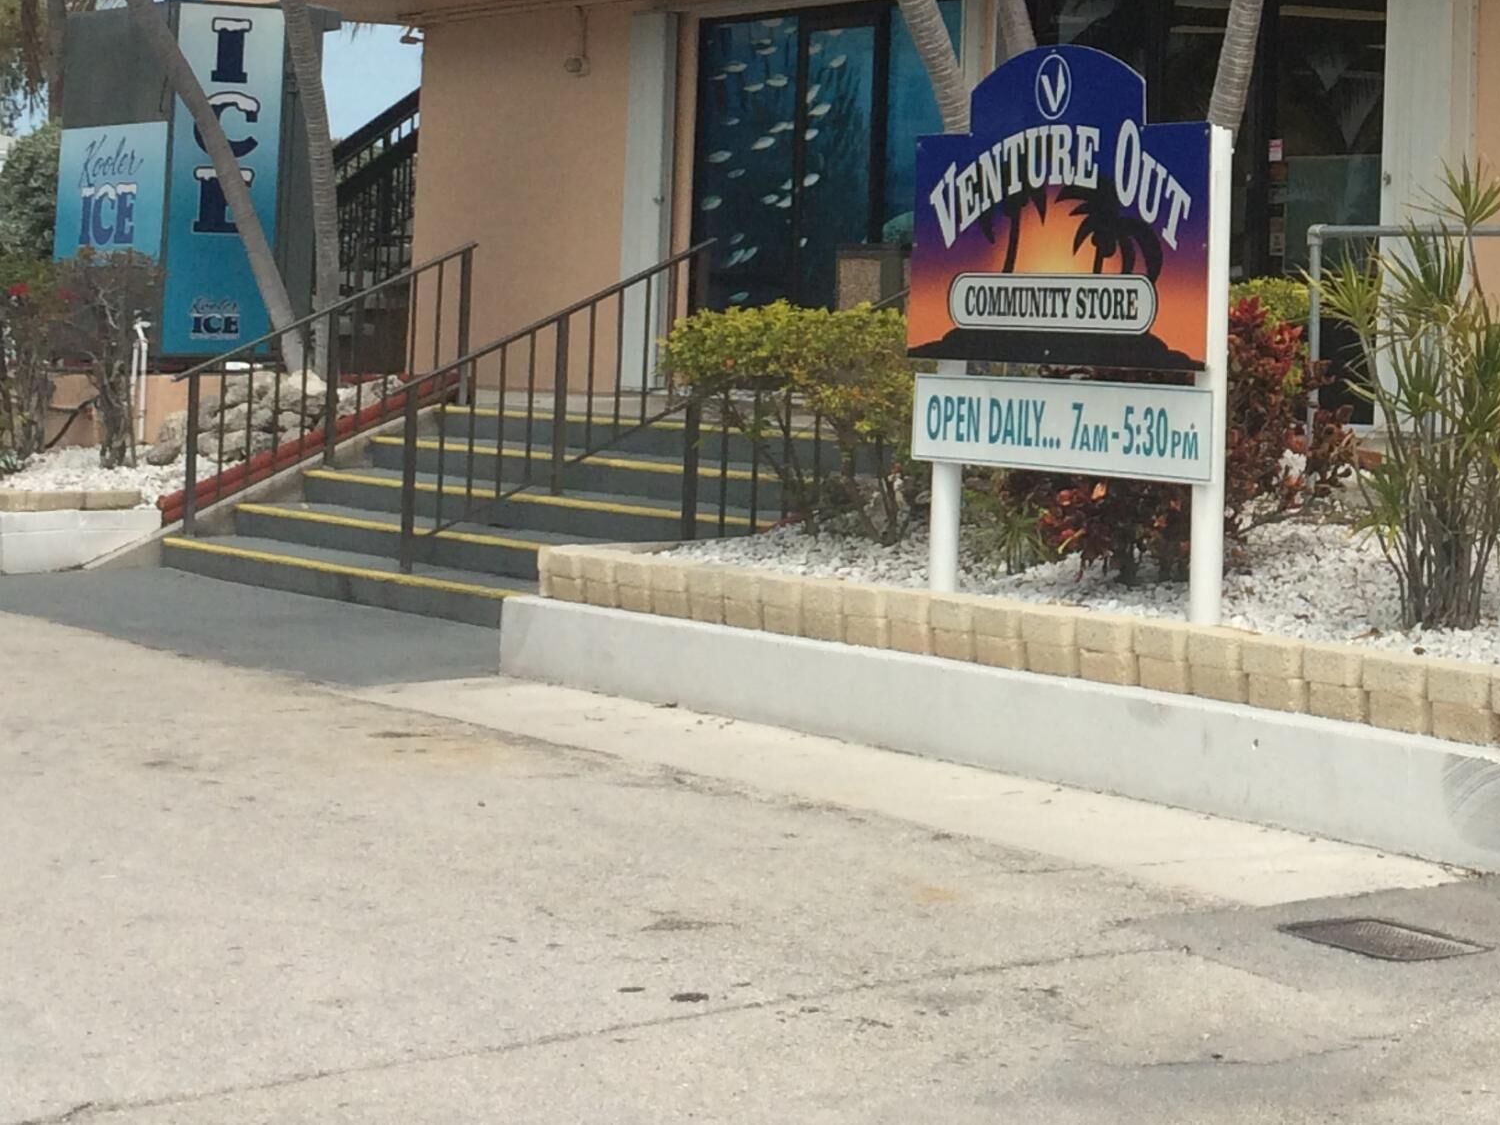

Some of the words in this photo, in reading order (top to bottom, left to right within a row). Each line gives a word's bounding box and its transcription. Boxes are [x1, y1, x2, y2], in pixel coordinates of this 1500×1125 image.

[1041, 62, 1066, 114] V
[929, 124, 1100, 250] VENTURE
[1115, 118, 1192, 251] OUT
[79, 182, 137, 245] ICE
[191, 314, 240, 334] ICE
[964, 286, 1071, 320] COMMUNITY
[1075, 288, 1139, 321] STORE
[926, 394, 980, 443] OPEN
[988, 398, 1061, 451] DAILY...
